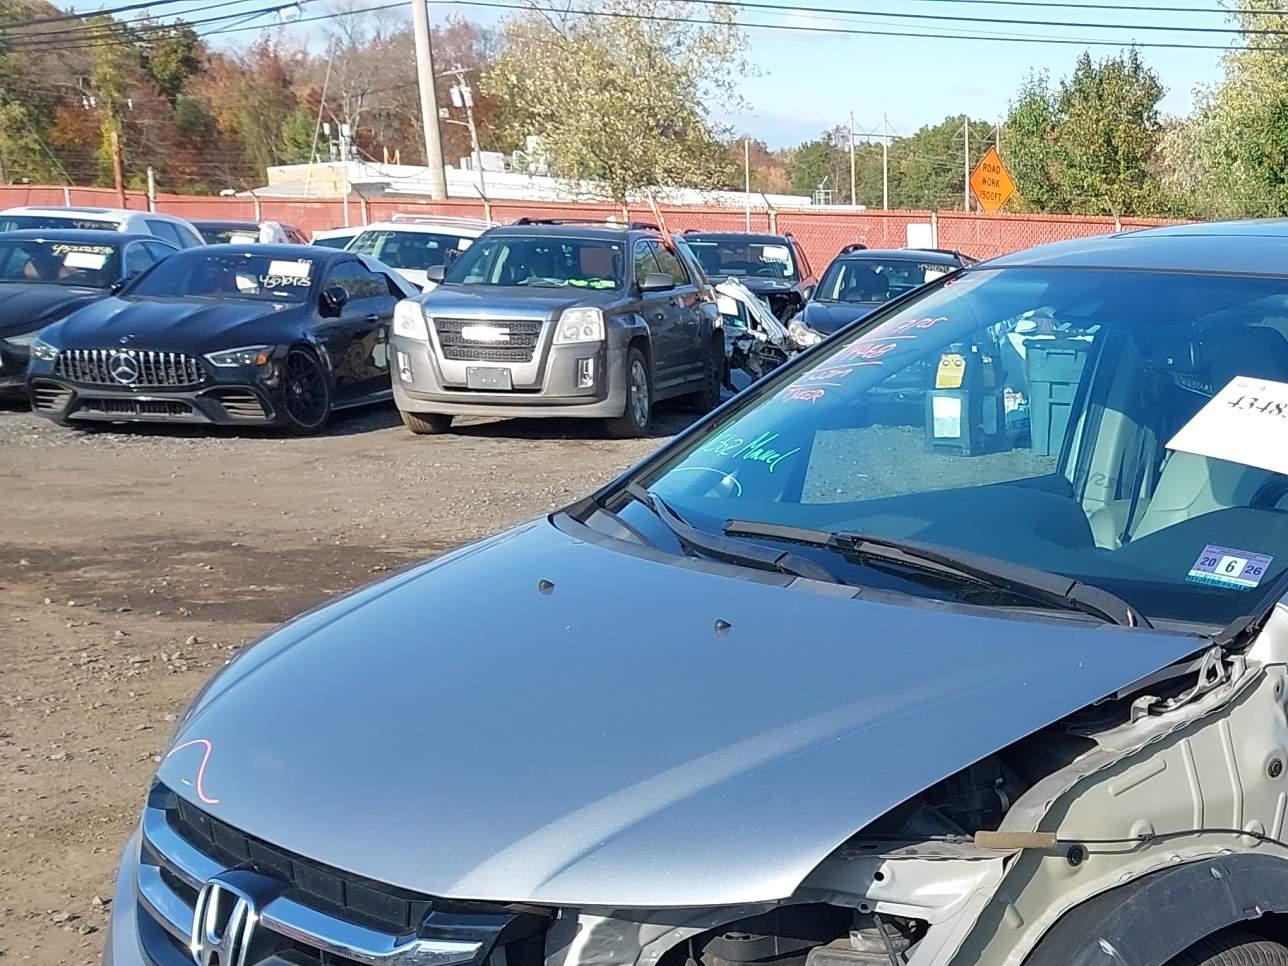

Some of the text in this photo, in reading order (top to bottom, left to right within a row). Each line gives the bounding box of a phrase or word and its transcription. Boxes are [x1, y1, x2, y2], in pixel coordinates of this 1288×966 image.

[982, 162, 1001, 175] ROAD
[981, 176, 1000, 188] WORK
[1199, 556, 1263, 576] 20 6 26
